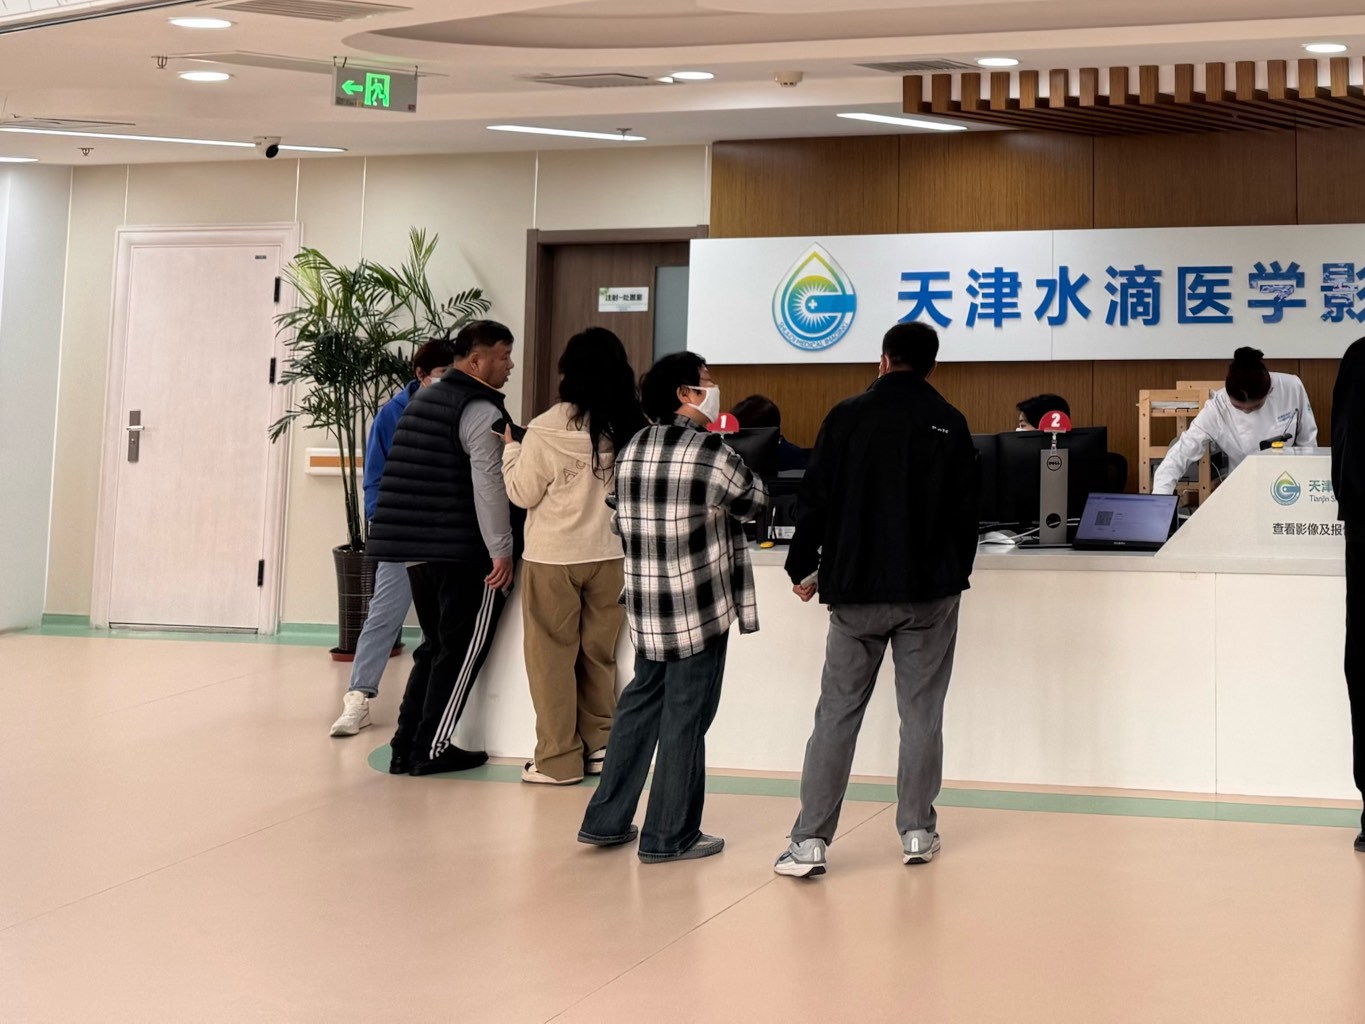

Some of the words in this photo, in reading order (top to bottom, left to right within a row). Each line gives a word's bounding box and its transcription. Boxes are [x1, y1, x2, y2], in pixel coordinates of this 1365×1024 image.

[720, 414, 727, 429] 1
[1051, 413, 1061, 428] 2
[1272, 522, 1345, 536] 查看影像及报
